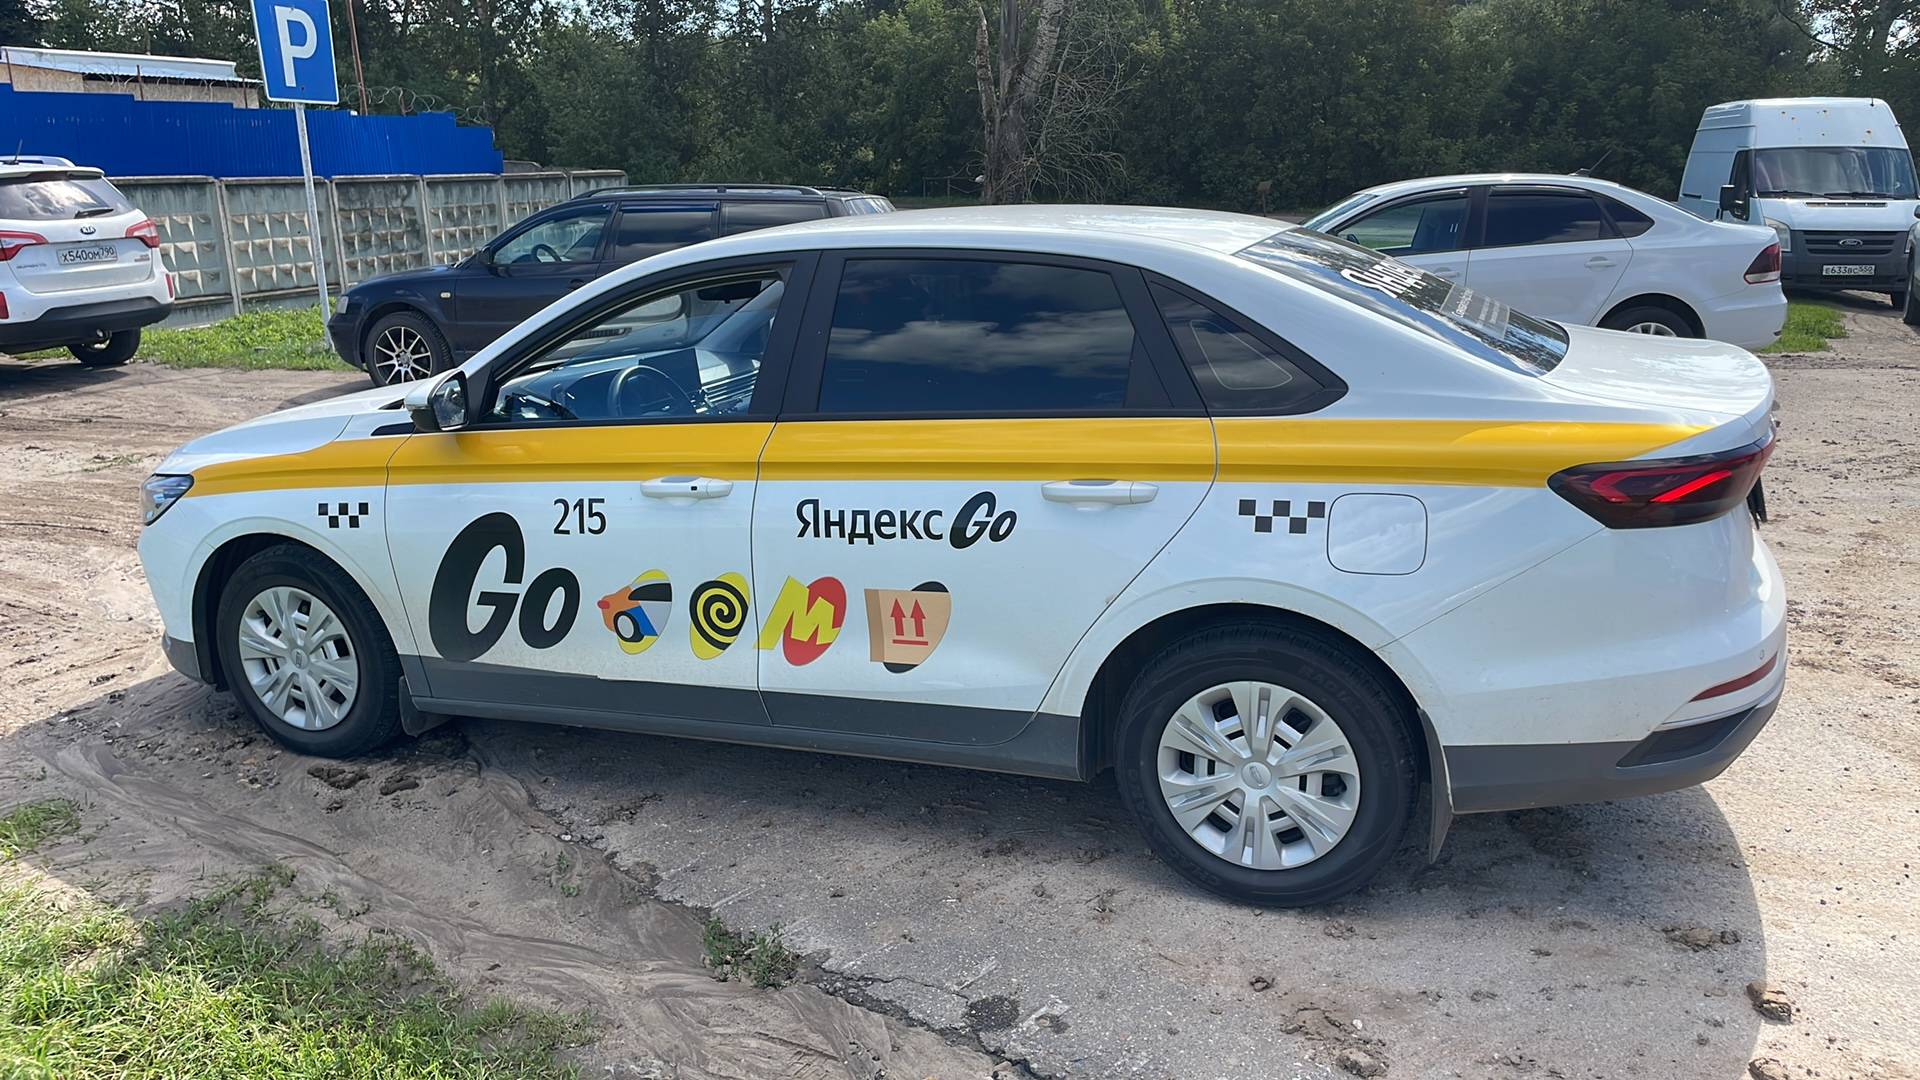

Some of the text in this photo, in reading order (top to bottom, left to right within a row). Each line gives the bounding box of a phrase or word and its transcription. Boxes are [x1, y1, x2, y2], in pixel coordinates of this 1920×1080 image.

[274, 5, 317, 88] P
[553, 498, 607, 535] 215
[796, 490, 1018, 550] Яндекс Go
[428, 511, 581, 663] Go
